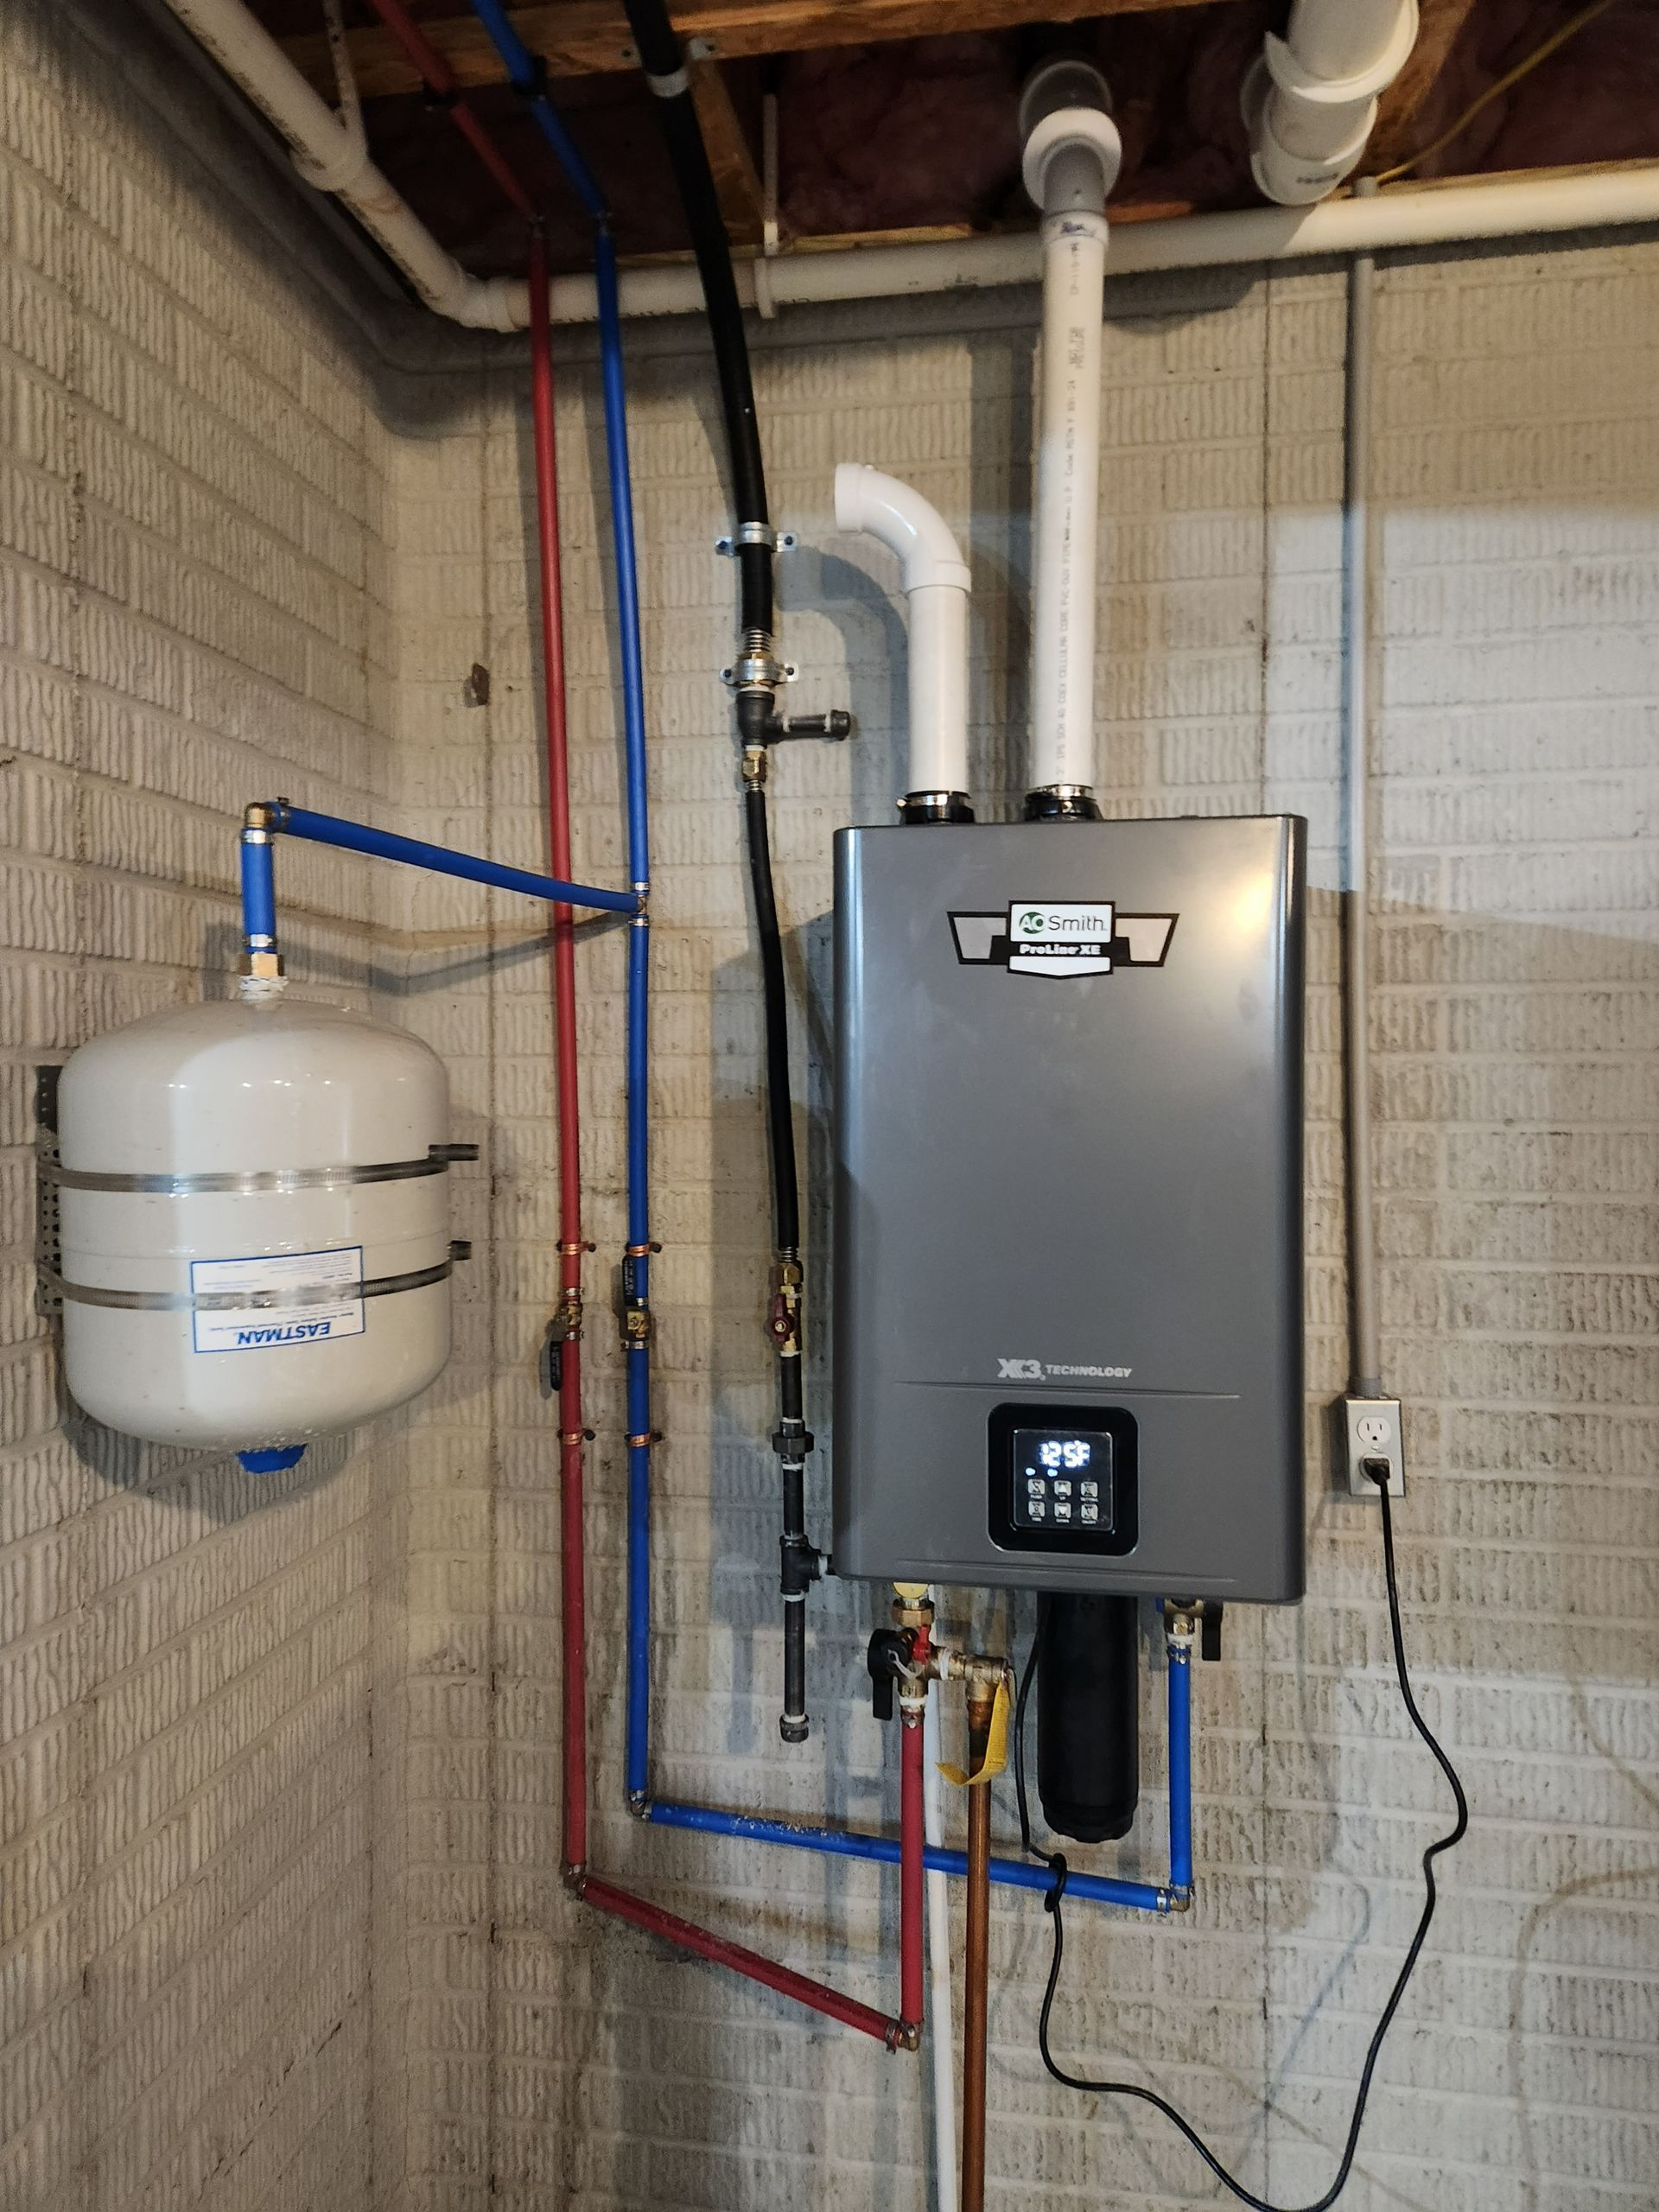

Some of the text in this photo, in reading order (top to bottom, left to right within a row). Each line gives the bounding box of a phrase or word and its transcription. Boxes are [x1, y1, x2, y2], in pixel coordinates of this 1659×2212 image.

[1058, 609, 1069, 632] CORE
[1058, 636, 1067, 678] CELLULAR
[1048, 915, 1104, 931] Smith
[1020, 944, 1101, 956] ProLine XE
[238, 1321, 331, 1344] EASTMAN
[1046, 1364, 1132, 1378] TECHNOLOGY
